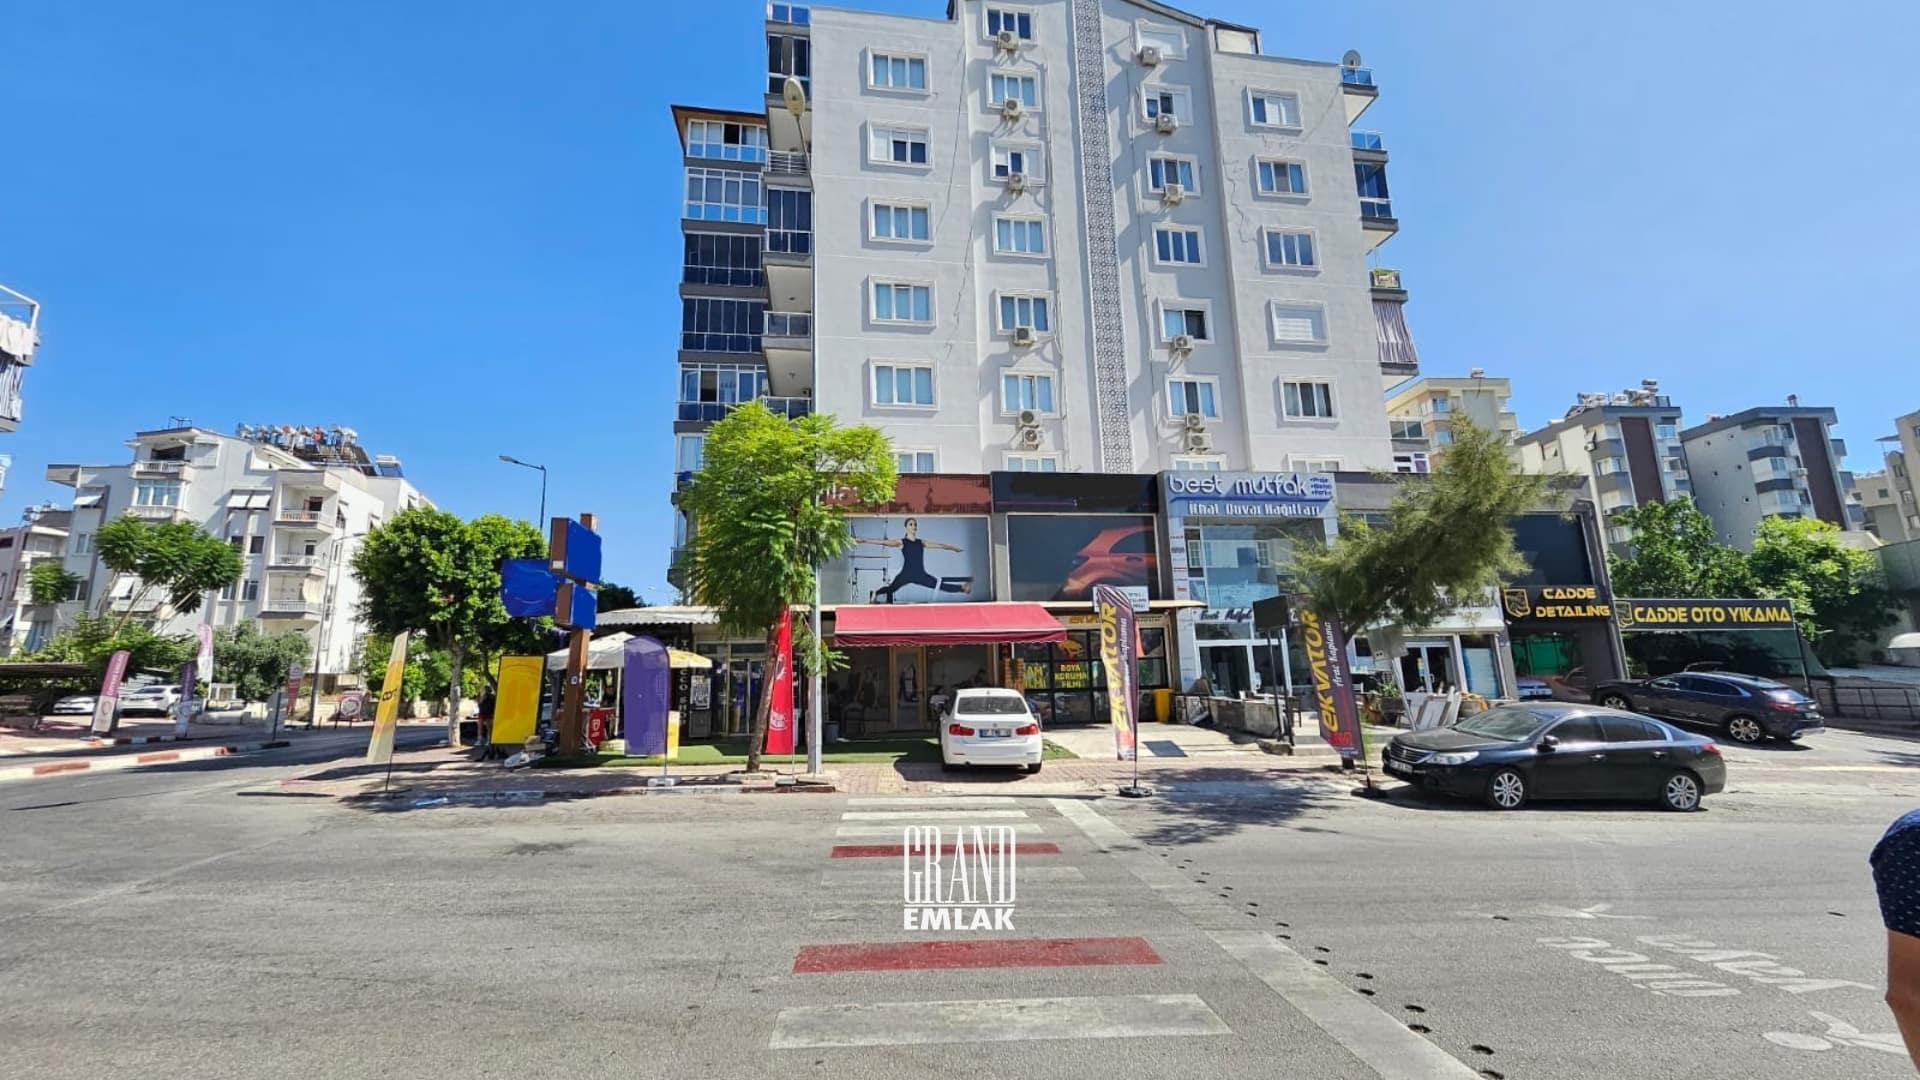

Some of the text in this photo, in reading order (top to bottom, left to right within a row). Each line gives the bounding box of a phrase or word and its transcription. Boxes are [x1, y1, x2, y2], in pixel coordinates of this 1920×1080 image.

[1168, 474, 1307, 495] best mutfak
[1542, 588, 1597, 600] CADDE
[1535, 604, 1612, 618] DETAILING
[1635, 606, 1792, 623] CADDE OTO YIKAMA
